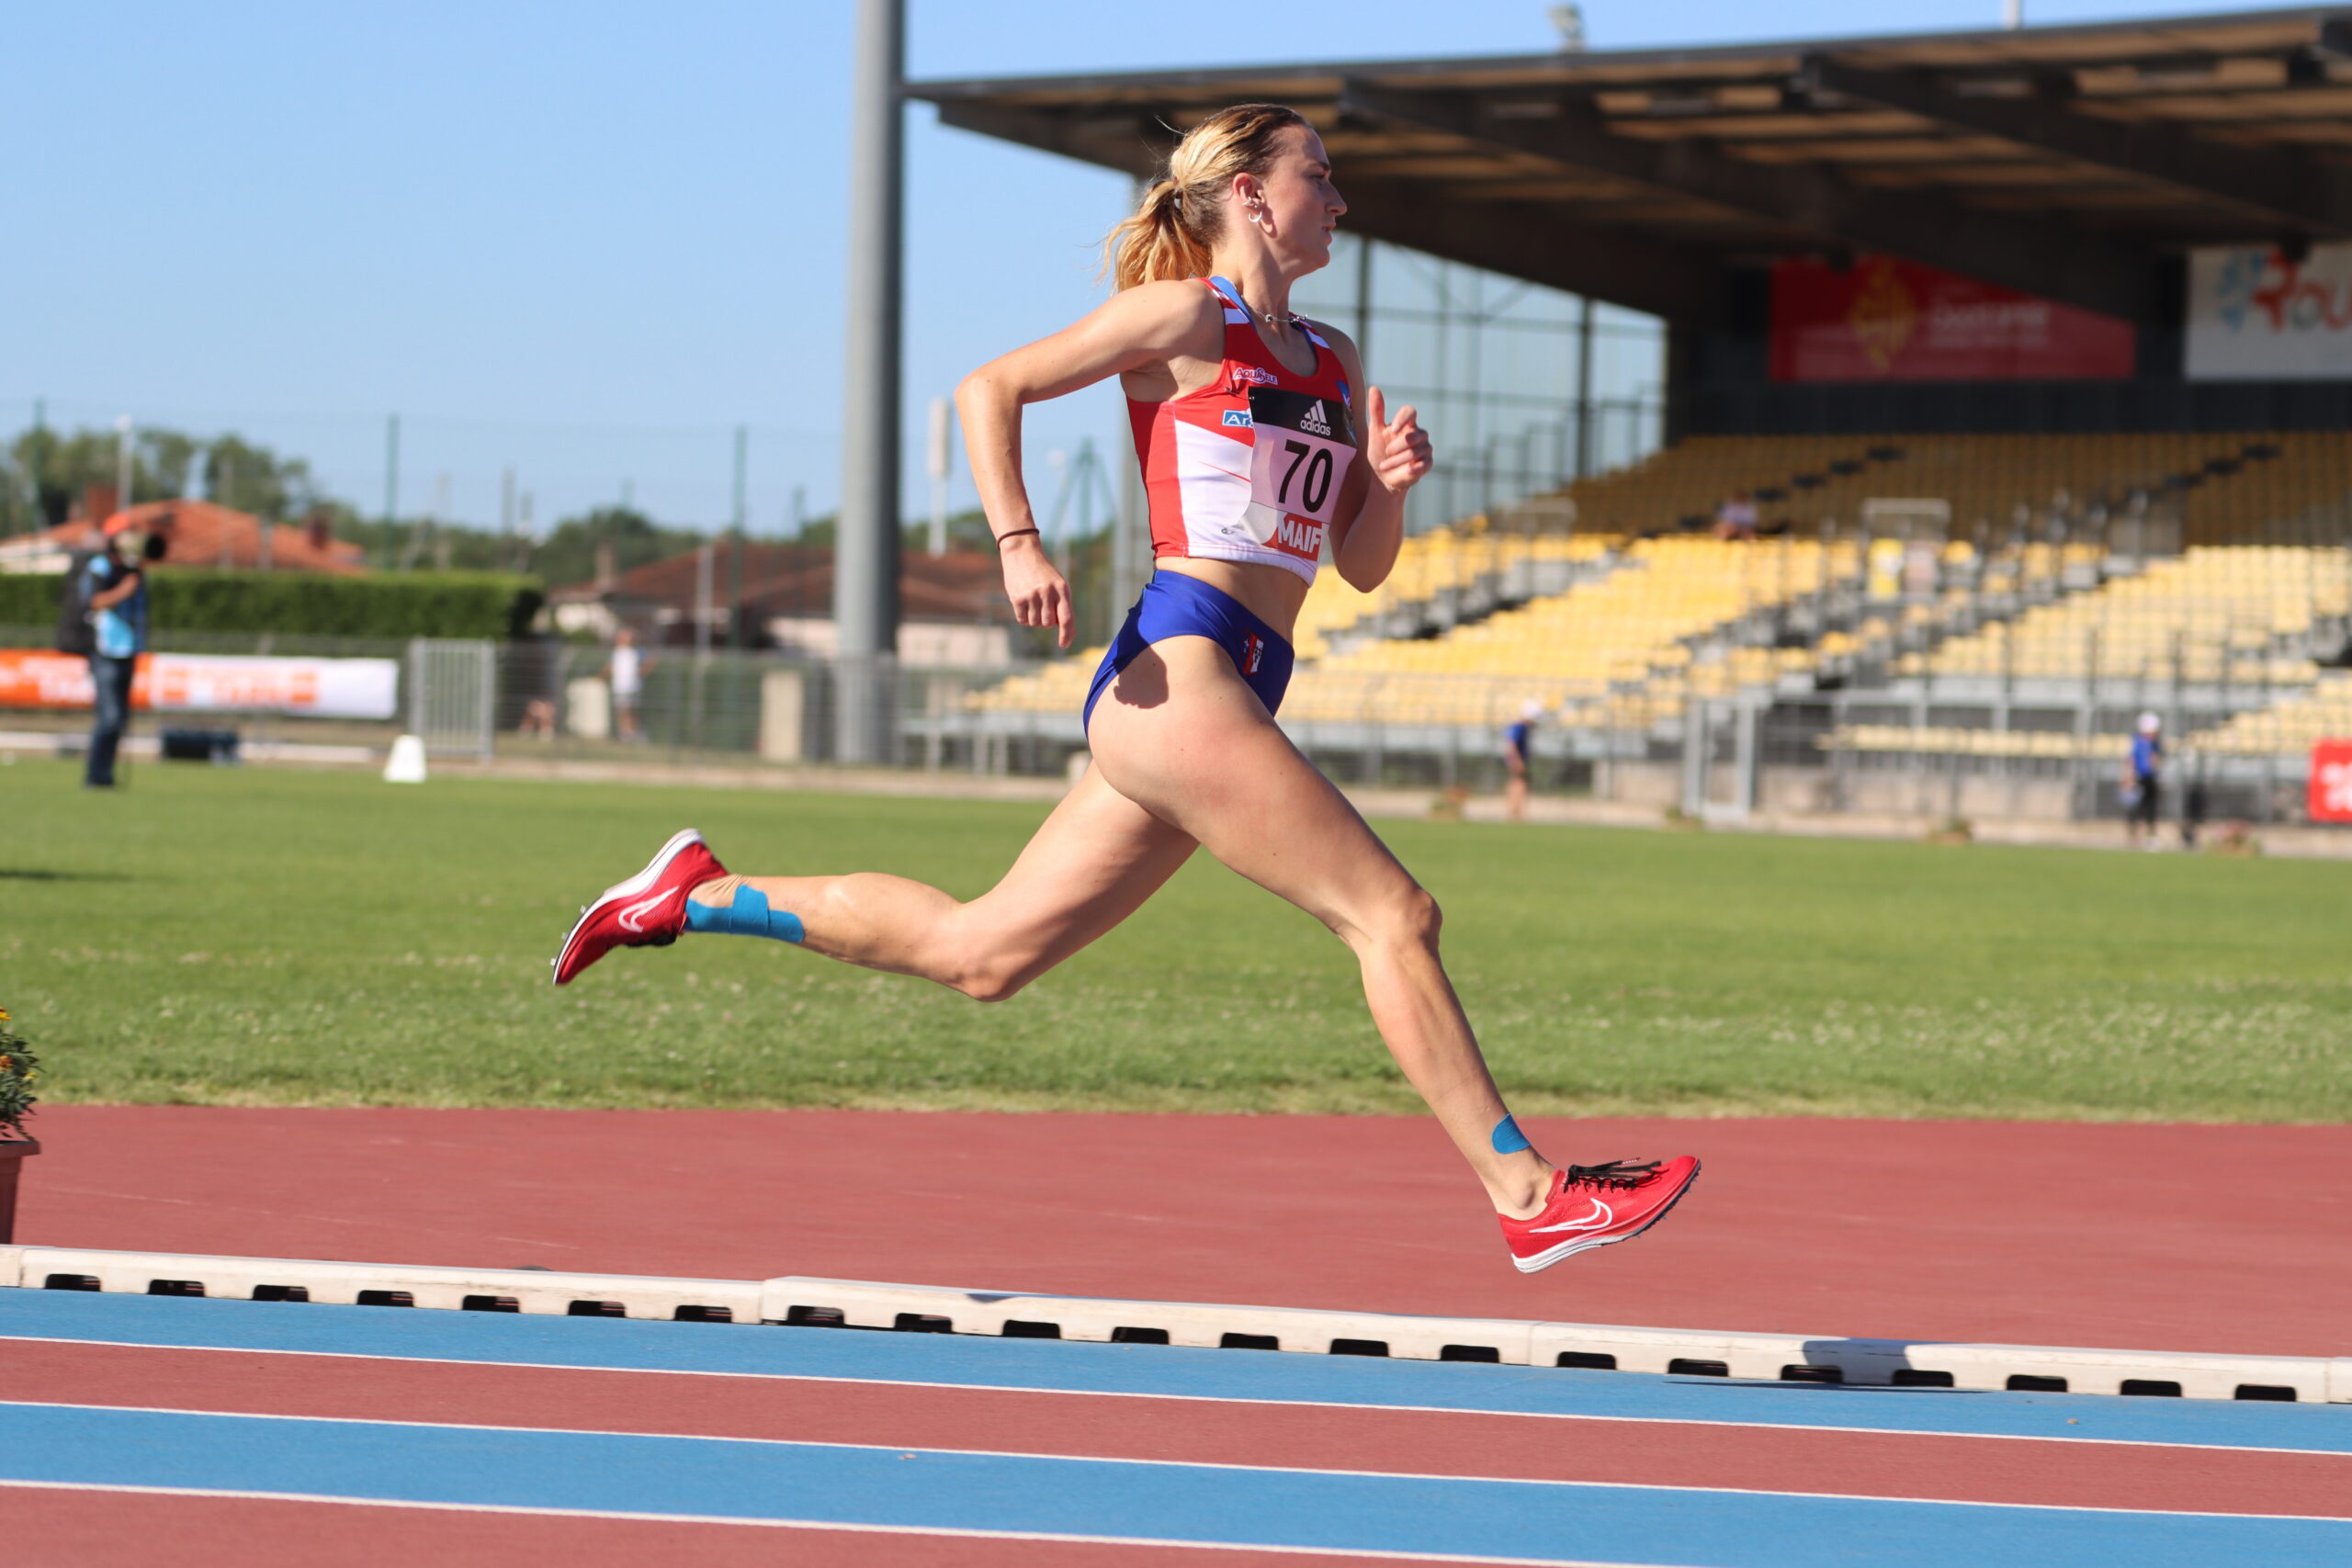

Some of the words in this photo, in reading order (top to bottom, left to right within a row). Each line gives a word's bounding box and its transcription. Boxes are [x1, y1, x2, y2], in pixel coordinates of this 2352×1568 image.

[1300, 419, 1331, 436] adidas
[1278, 438, 1333, 513] 70
[1277, 516, 1323, 553] MAIF
